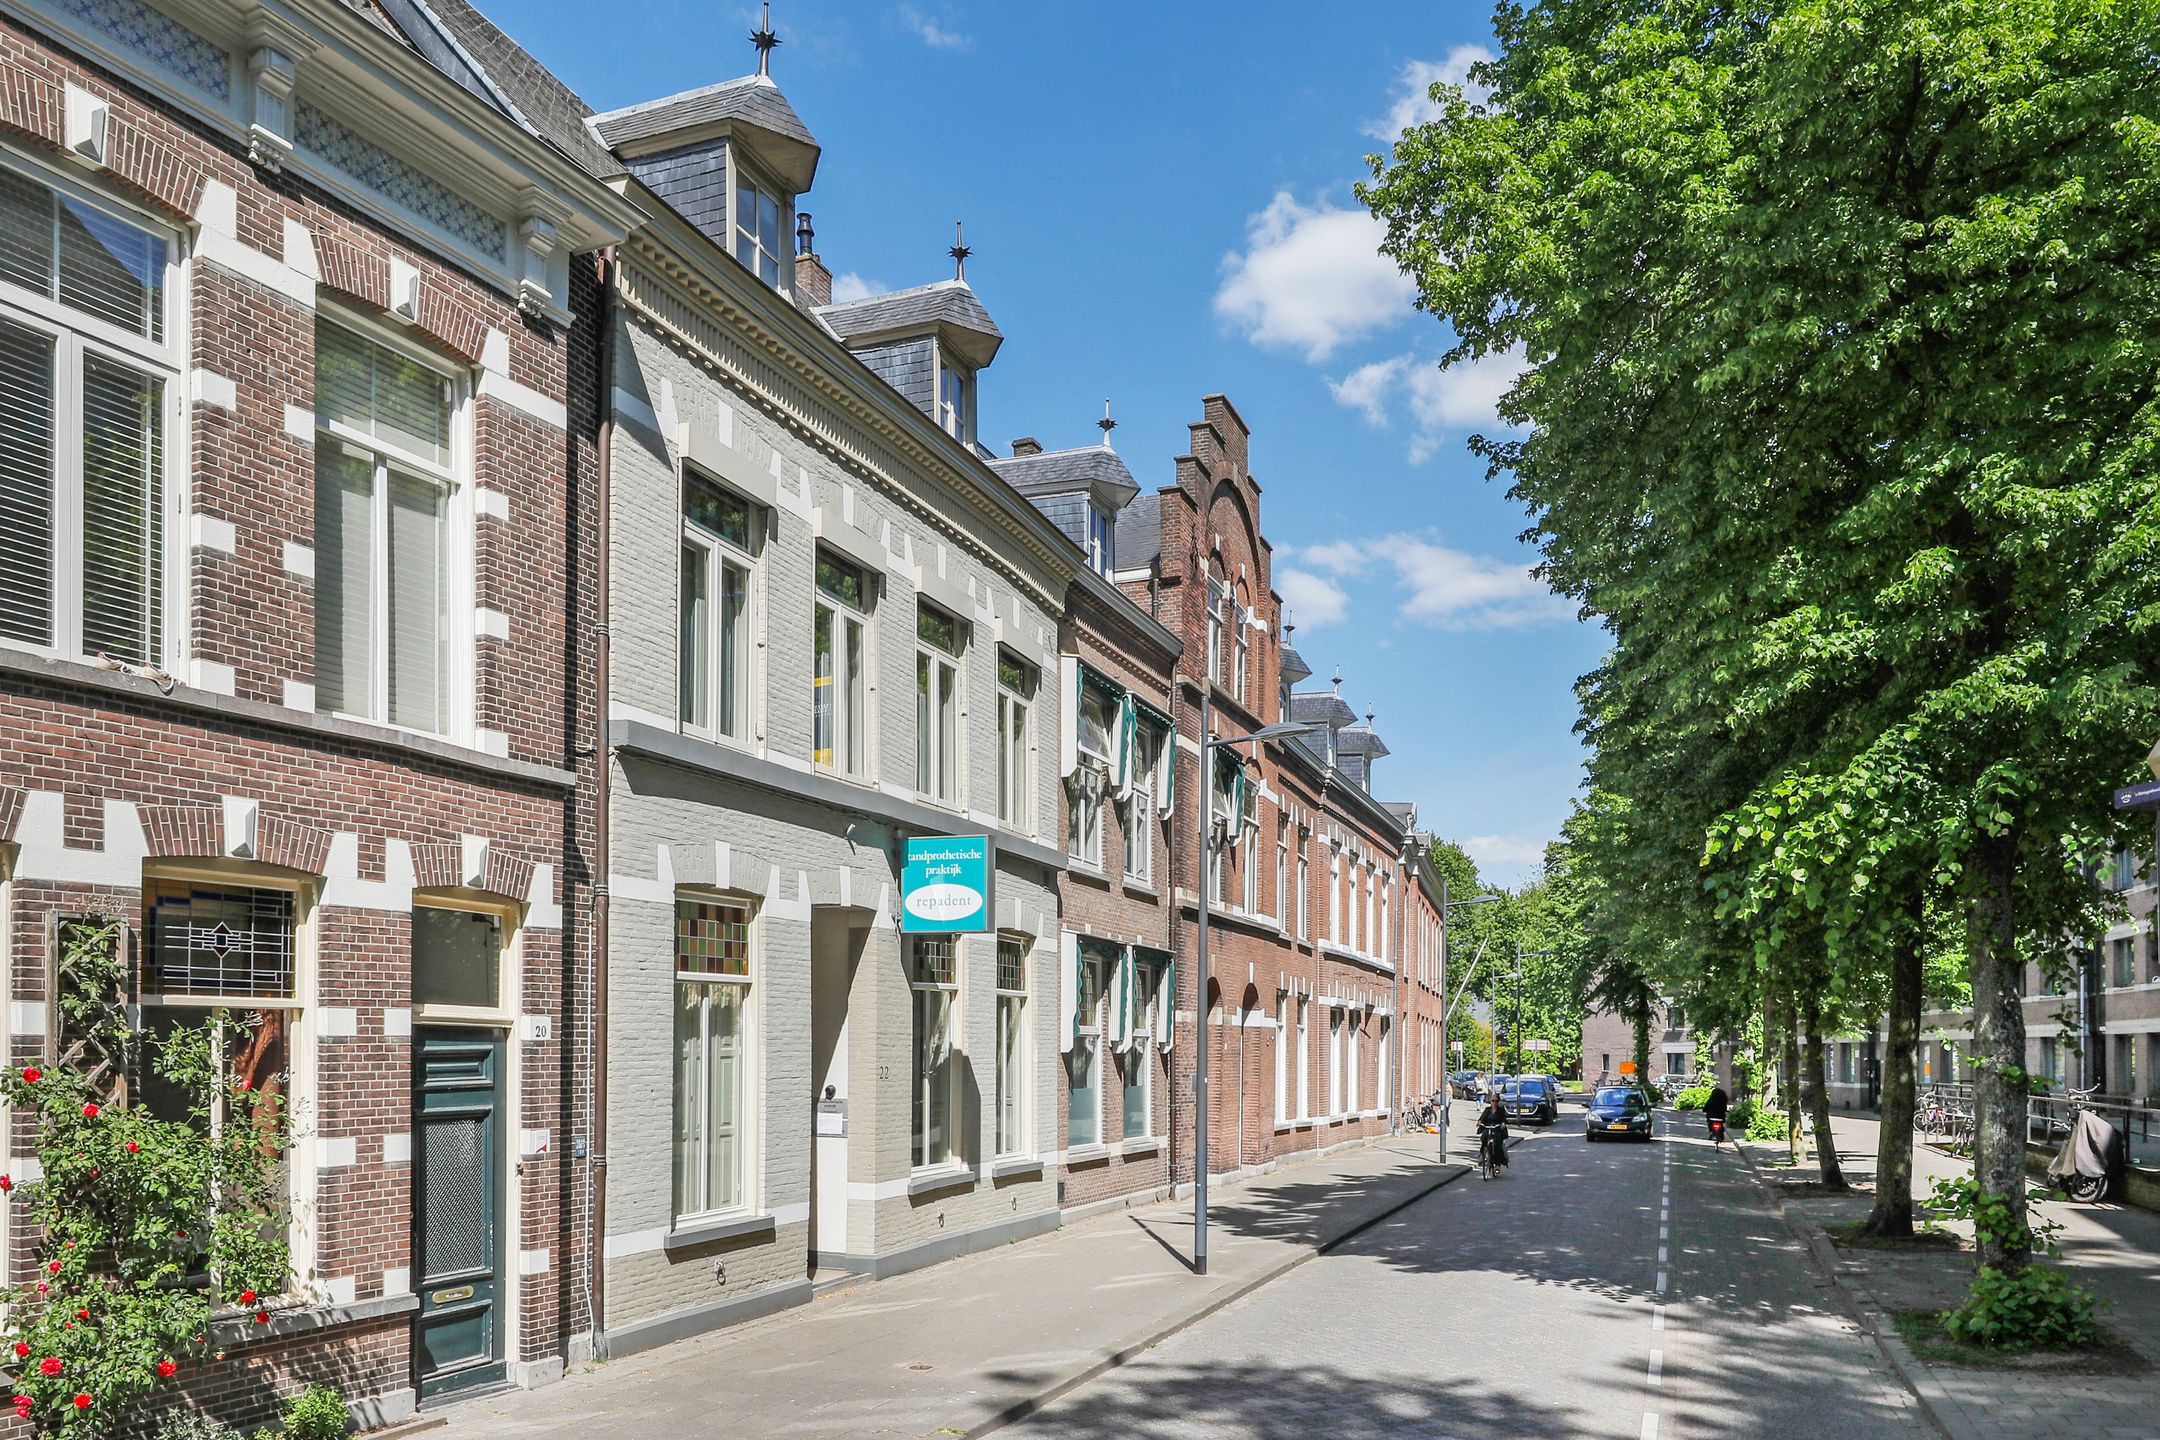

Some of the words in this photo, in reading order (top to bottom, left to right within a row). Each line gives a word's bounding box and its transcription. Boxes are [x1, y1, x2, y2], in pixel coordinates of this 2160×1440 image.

[925, 864, 962, 878] praktijk
[916, 894, 971, 909] repadent
[535, 1025, 547, 1038] 20
[879, 1066, 889, 1079] 22
